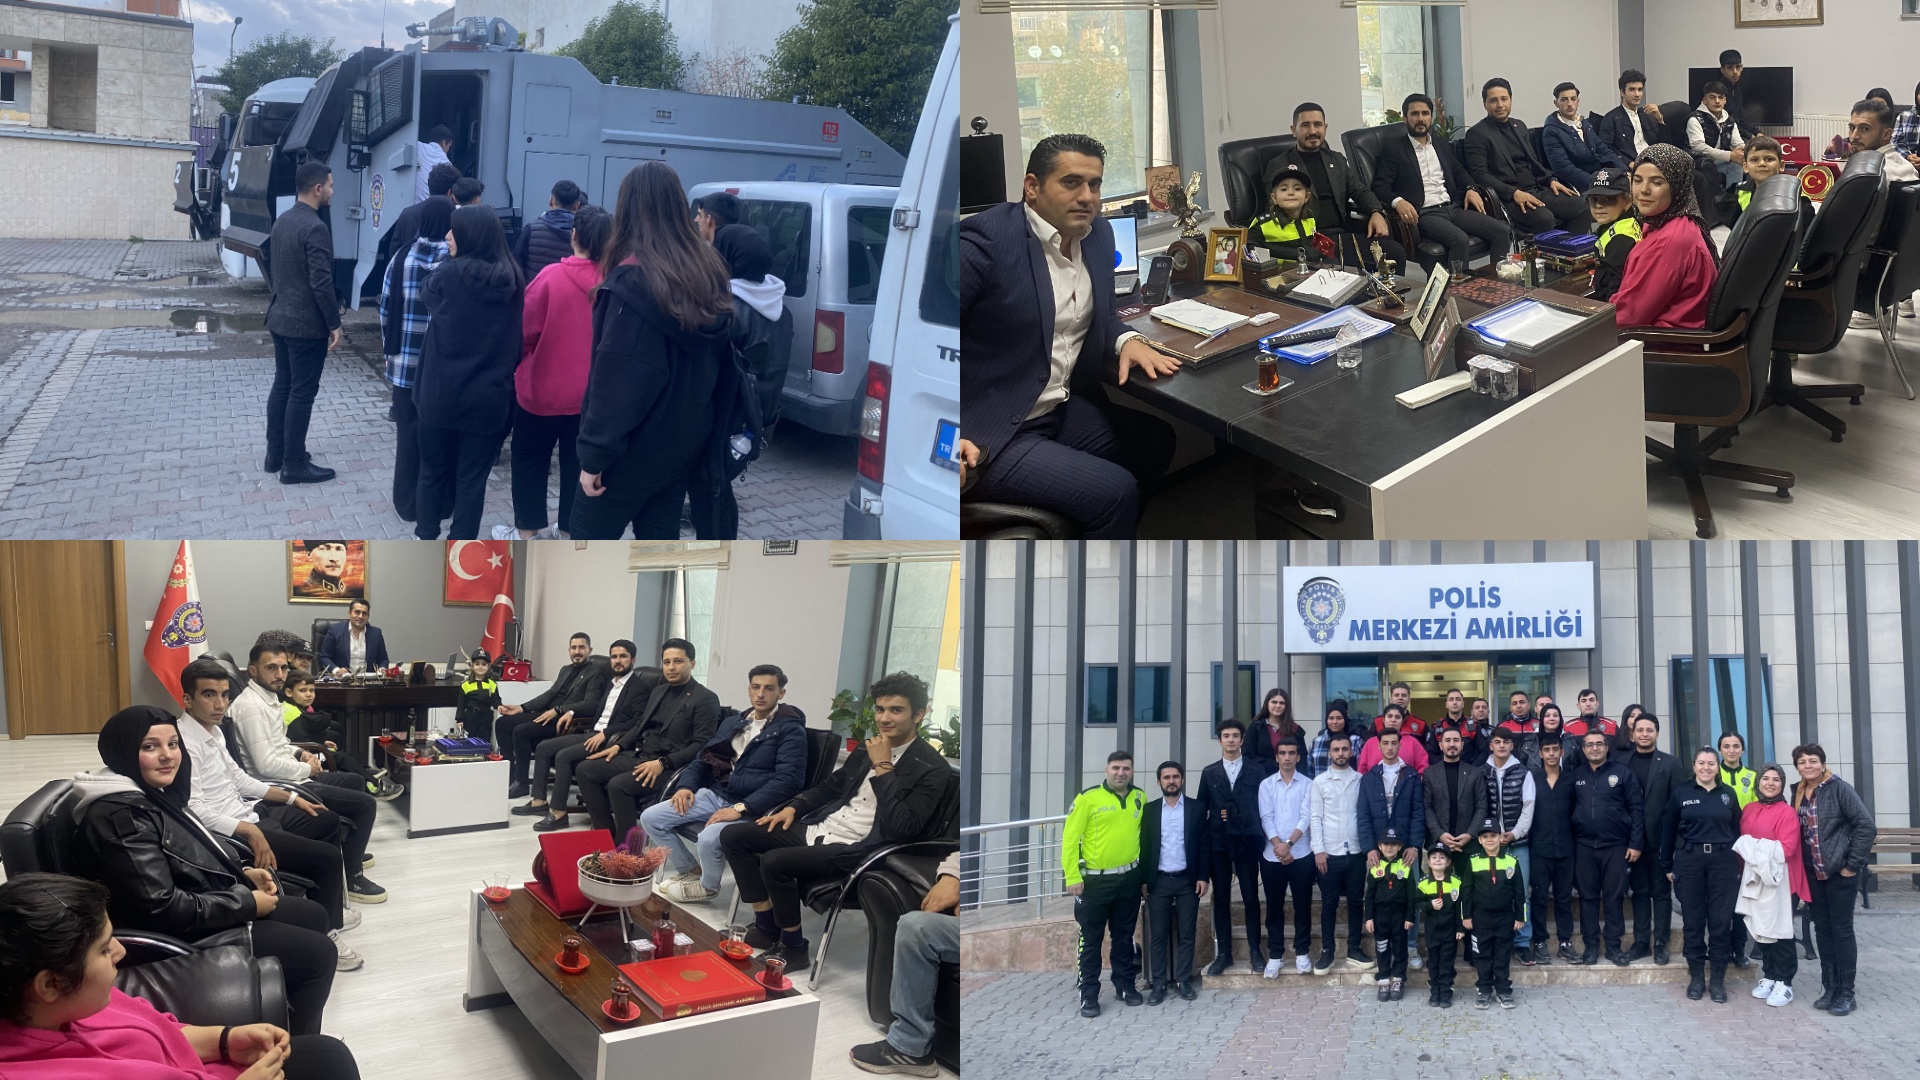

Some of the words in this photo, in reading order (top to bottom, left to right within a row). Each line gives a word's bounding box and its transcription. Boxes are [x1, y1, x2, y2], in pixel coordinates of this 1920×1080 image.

[825, 124, 837, 134] 112
[174, 163, 181, 184] 2
[228, 152, 242, 191] 5
[940, 442, 951, 454] TR
[1429, 580, 1502, 609] POLİS
[1349, 611, 1457, 641] MERKEZİ
[1465, 609, 1582, 640] AMİRLİĞİ
